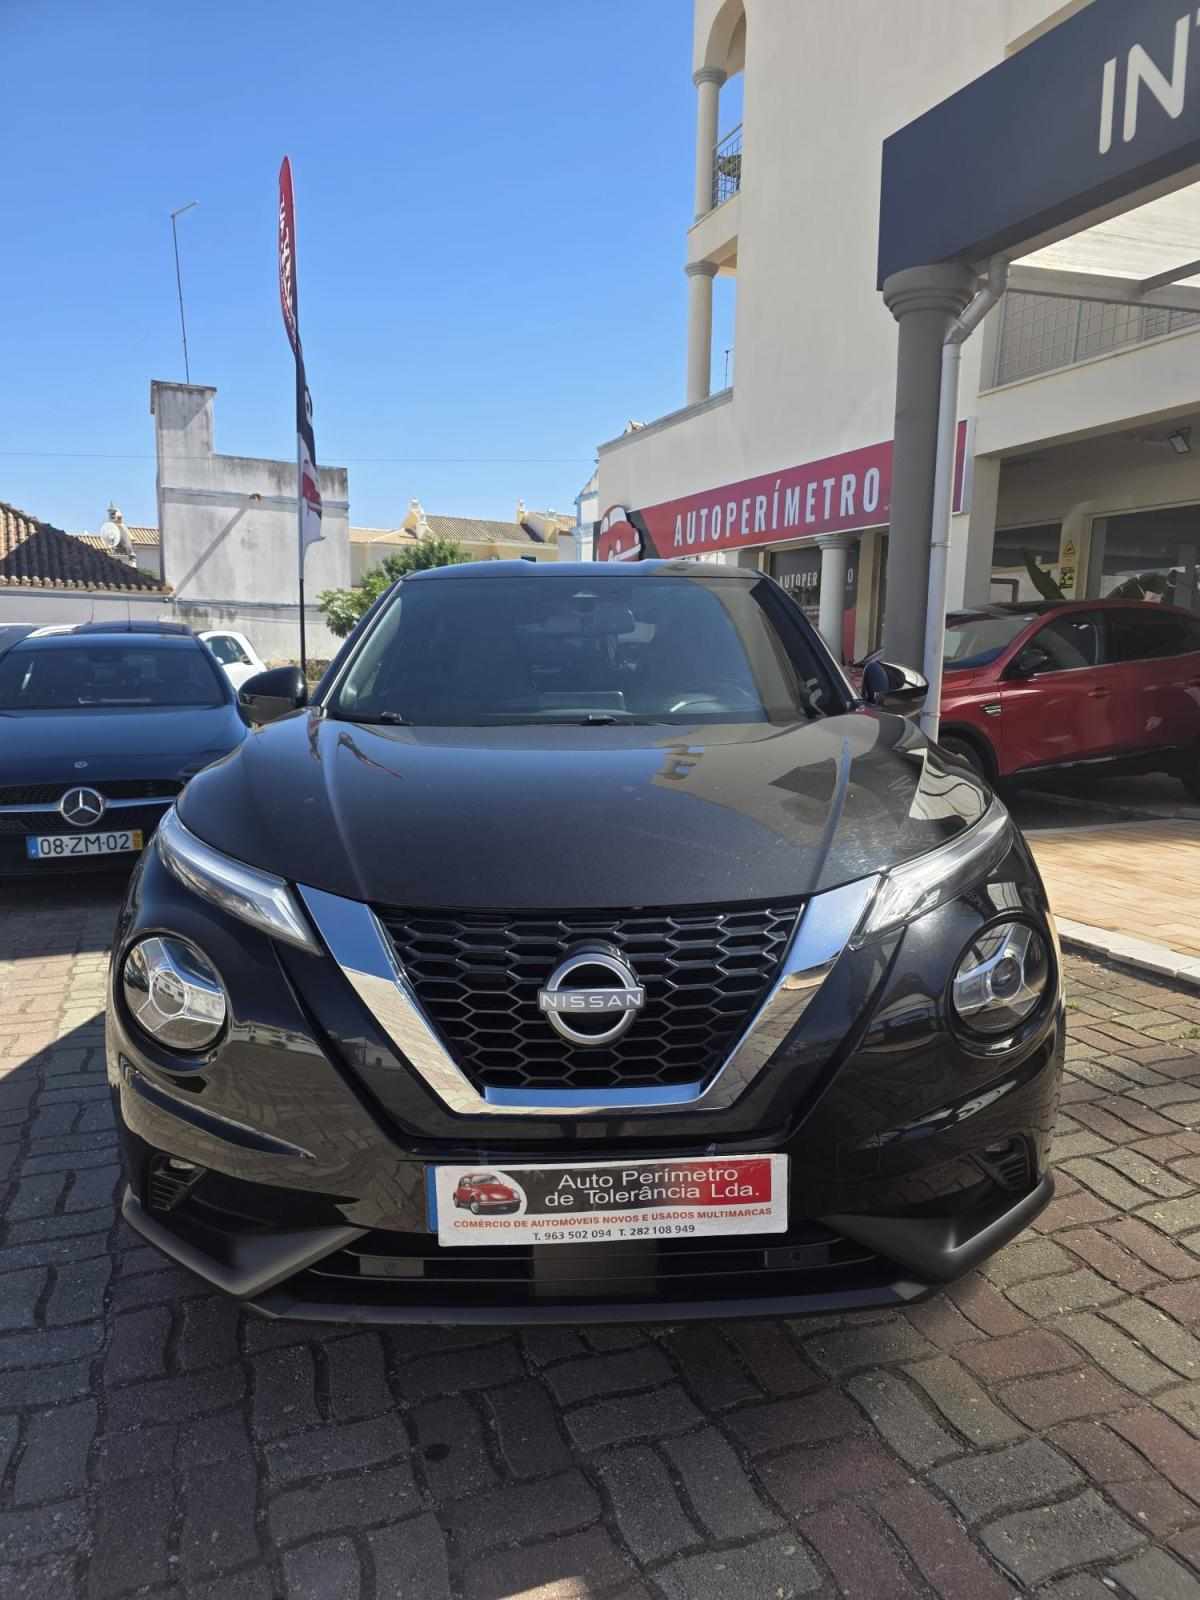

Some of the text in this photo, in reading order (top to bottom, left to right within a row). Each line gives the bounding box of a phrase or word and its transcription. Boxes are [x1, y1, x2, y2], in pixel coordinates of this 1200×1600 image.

[1098, 7, 1200, 155] IN
[674, 467, 880, 547] AUTOPERÍMETRO
[542, 992, 640, 1008] NISSAN
[557, 1167, 738, 1190] Auto Perímetro
[545, 1182, 760, 1206] de Tolerância Lda.
[513, 1219, 528, 1228] DE
[602, 1214, 640, 1224] NOVOS
[651, 1211, 695, 1221] USADOS
[697, 1207, 772, 1219] MULTIMARCAS
[533, 1224, 696, 1241] T. 963 502 094 T. 282 108 949
